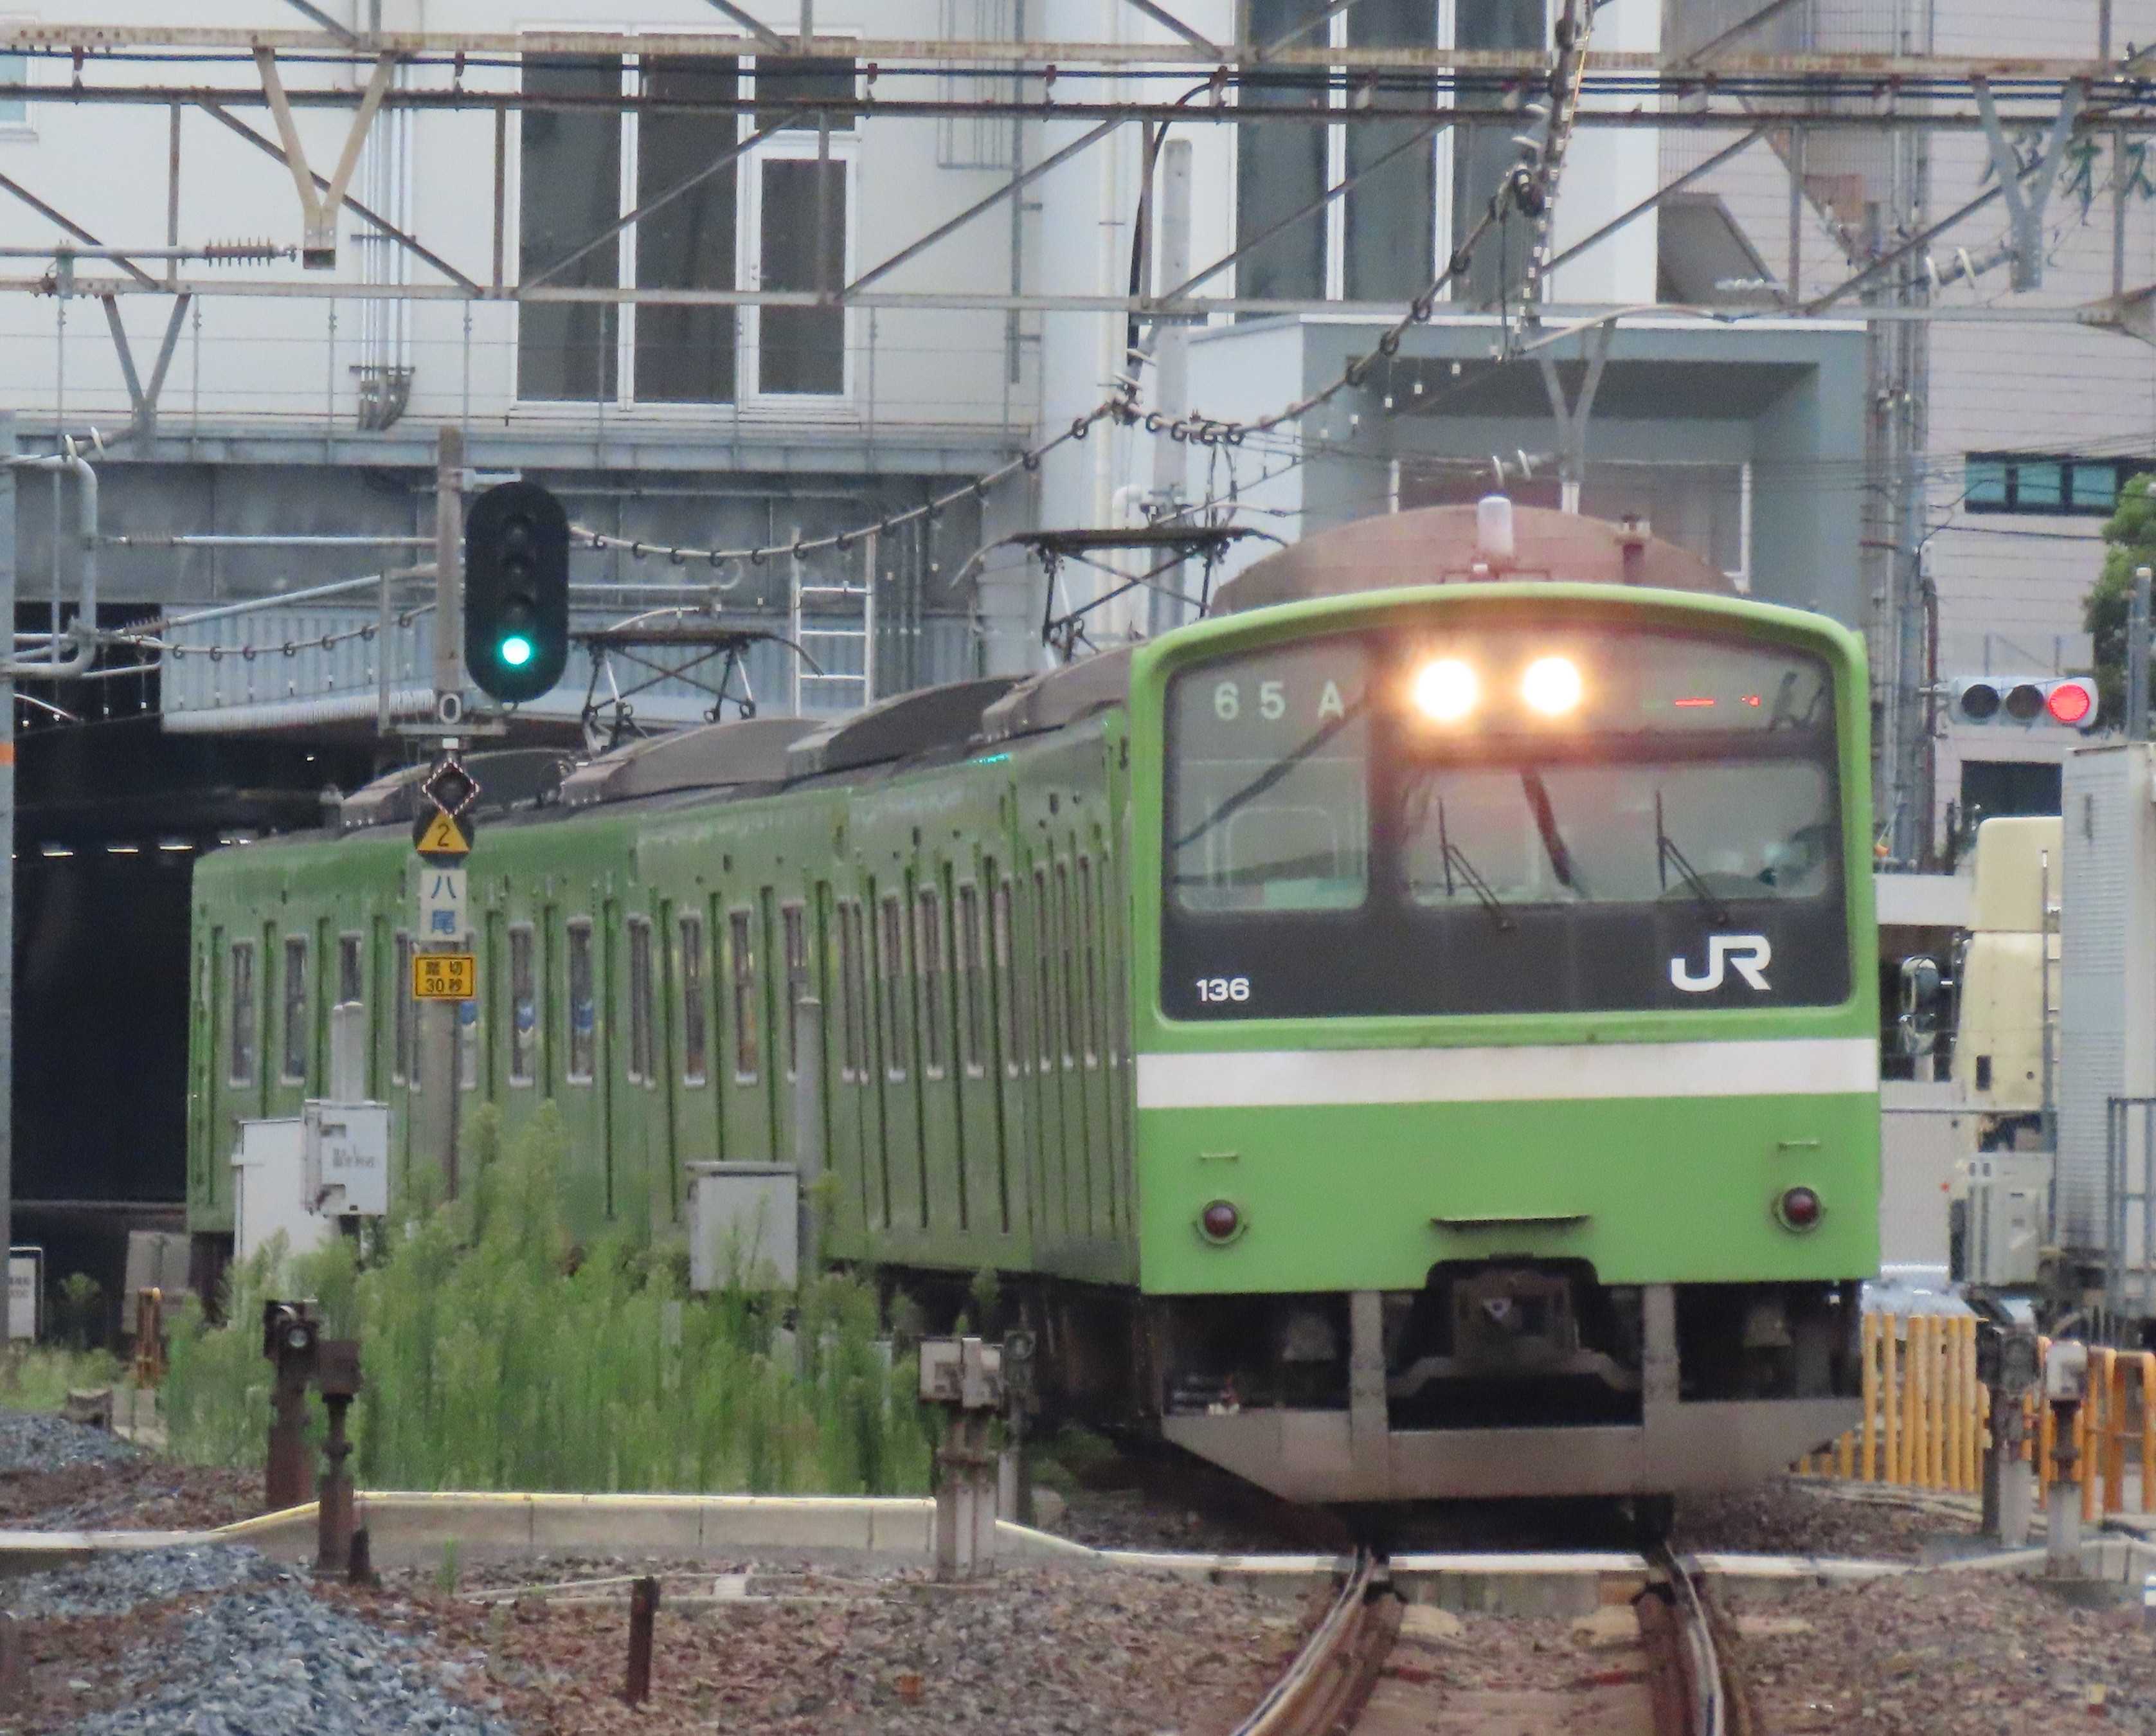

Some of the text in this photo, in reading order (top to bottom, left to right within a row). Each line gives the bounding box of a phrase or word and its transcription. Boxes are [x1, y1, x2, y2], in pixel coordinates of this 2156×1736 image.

[436, 823, 450, 847] 2
[1671, 936, 1772, 992] JR
[1196, 977, 1250, 1002] 136
